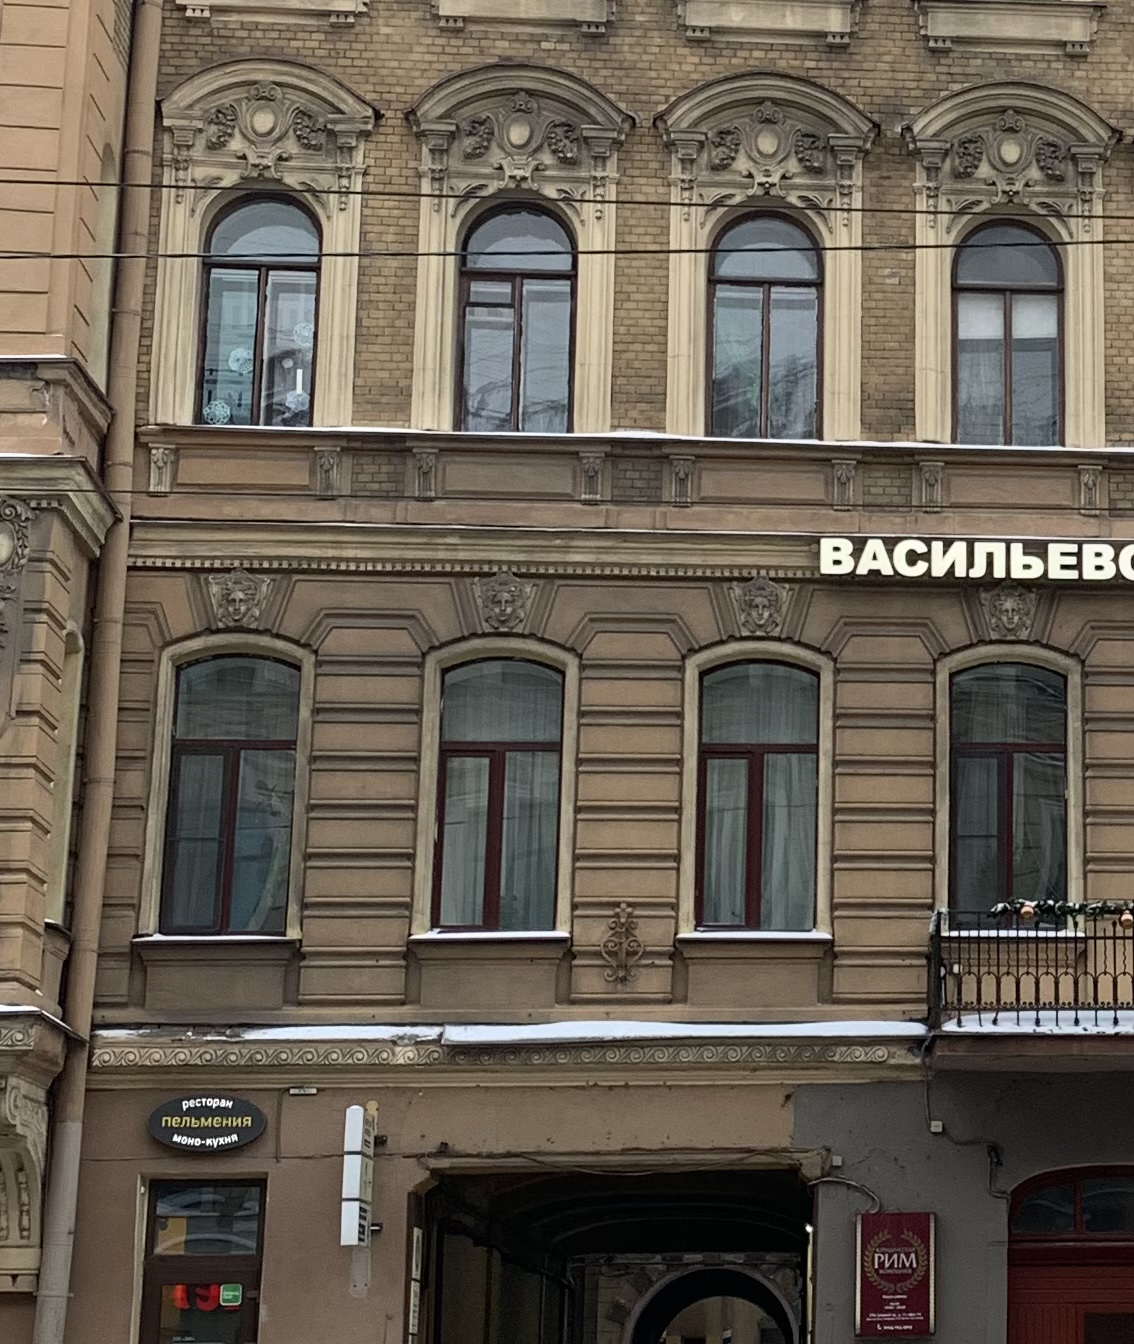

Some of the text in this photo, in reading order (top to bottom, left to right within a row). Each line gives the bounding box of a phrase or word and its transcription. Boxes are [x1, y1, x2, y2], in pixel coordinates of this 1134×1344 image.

[182, 1098, 233, 1111] ресторан
[162, 1116, 252, 1128] пельмения
[172, 1133, 239, 1148] моно-кухня
[874, 1252, 917, 1269] РИМ
